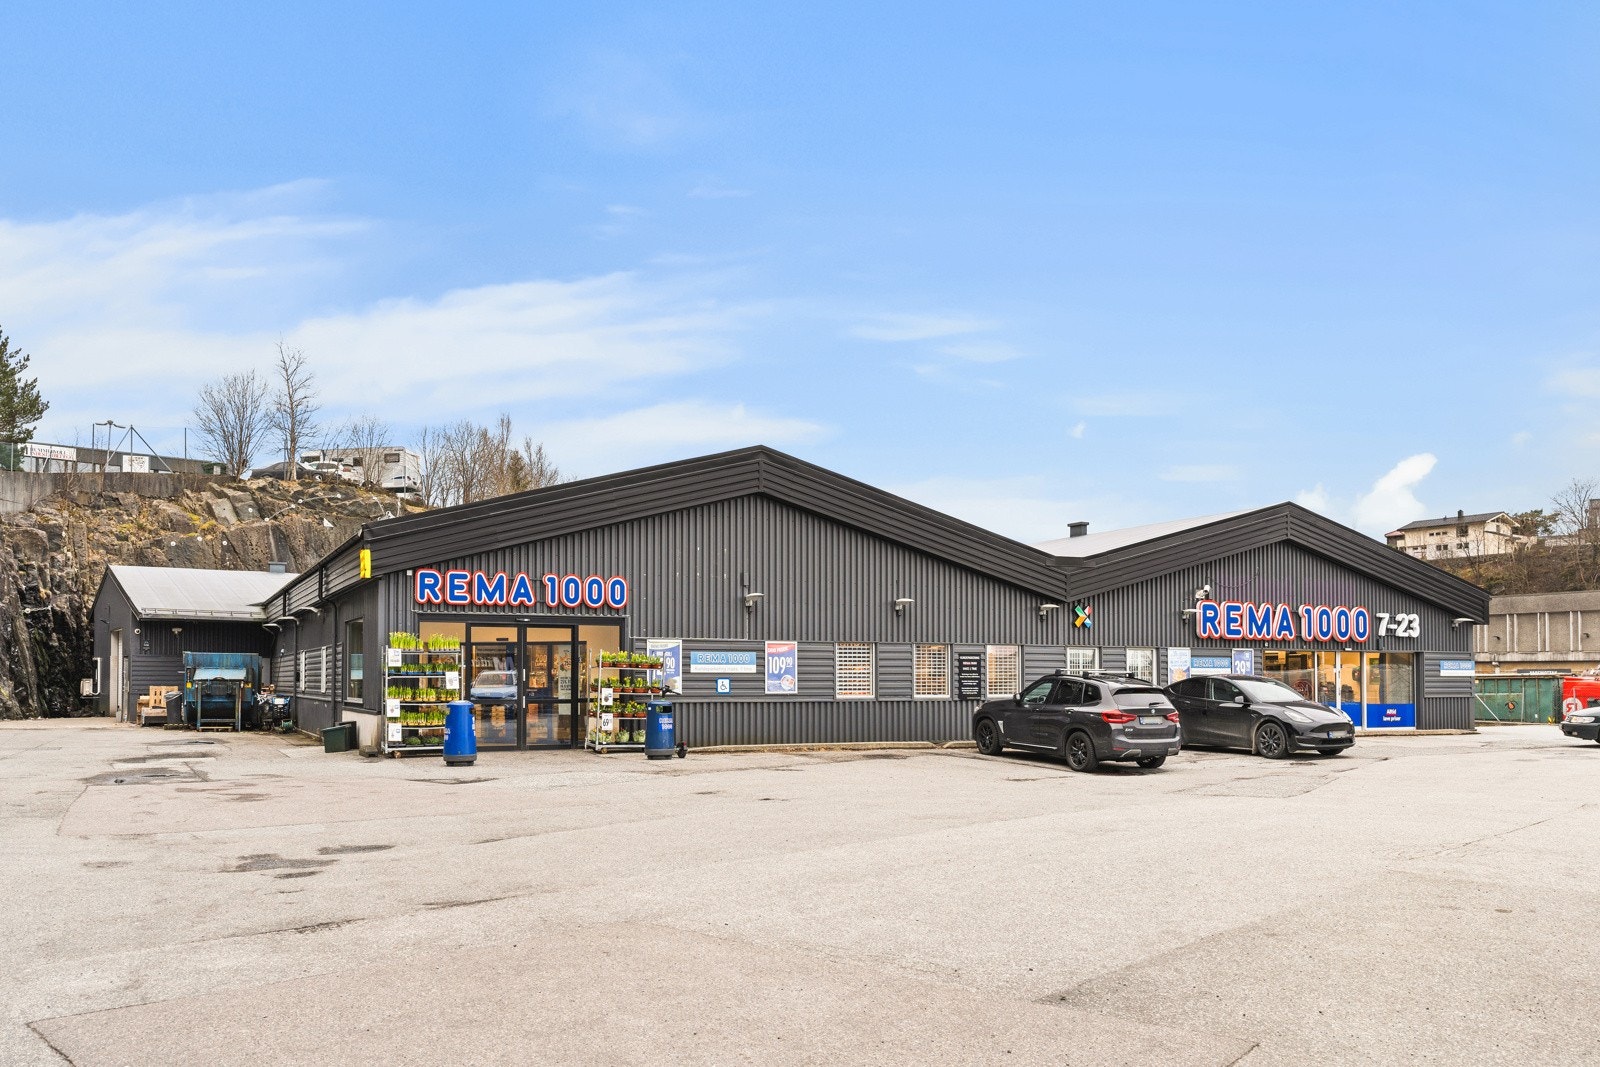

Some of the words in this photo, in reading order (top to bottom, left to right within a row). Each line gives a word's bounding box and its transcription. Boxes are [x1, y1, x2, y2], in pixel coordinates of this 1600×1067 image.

[415, 568, 536, 606] REMA
[543, 573, 629, 609] 1000
[1196, 600, 1297, 641] REMA
[1299, 604, 1371, 643] 1000
[1376, 613, 1420, 638] 7-23
[697, 653, 726, 664] REMA
[728, 653, 750, 664] 1000
[768, 656, 786, 674] 109
[1193, 658, 1213, 668] REMA
[1214, 658, 1229, 668] 1000
[1235, 660, 1246, 675] 39
